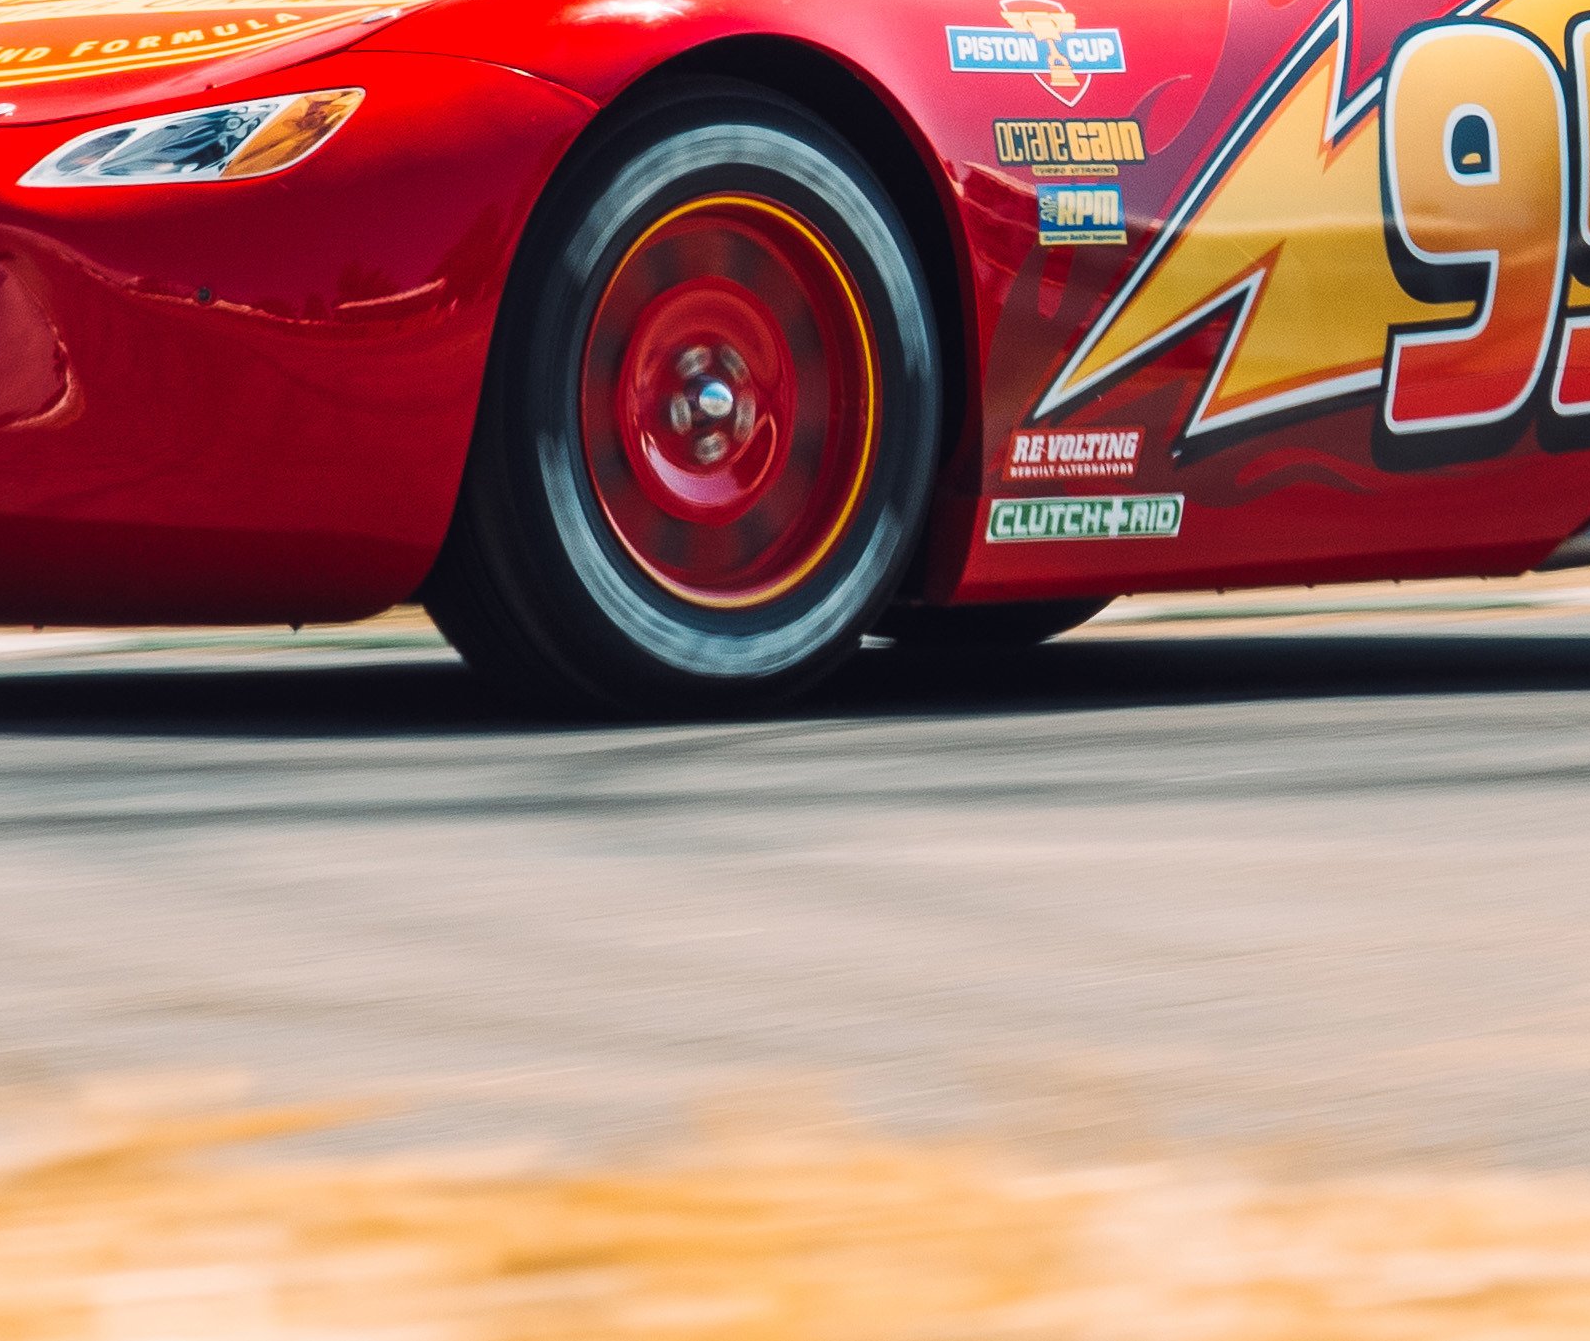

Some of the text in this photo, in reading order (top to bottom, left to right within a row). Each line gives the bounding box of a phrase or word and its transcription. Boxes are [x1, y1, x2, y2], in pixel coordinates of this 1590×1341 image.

[68, 12, 302, 58] FORMULA
[956, 35, 1115, 62] PISTON CUP
[1056, 190, 1120, 226] RPM
